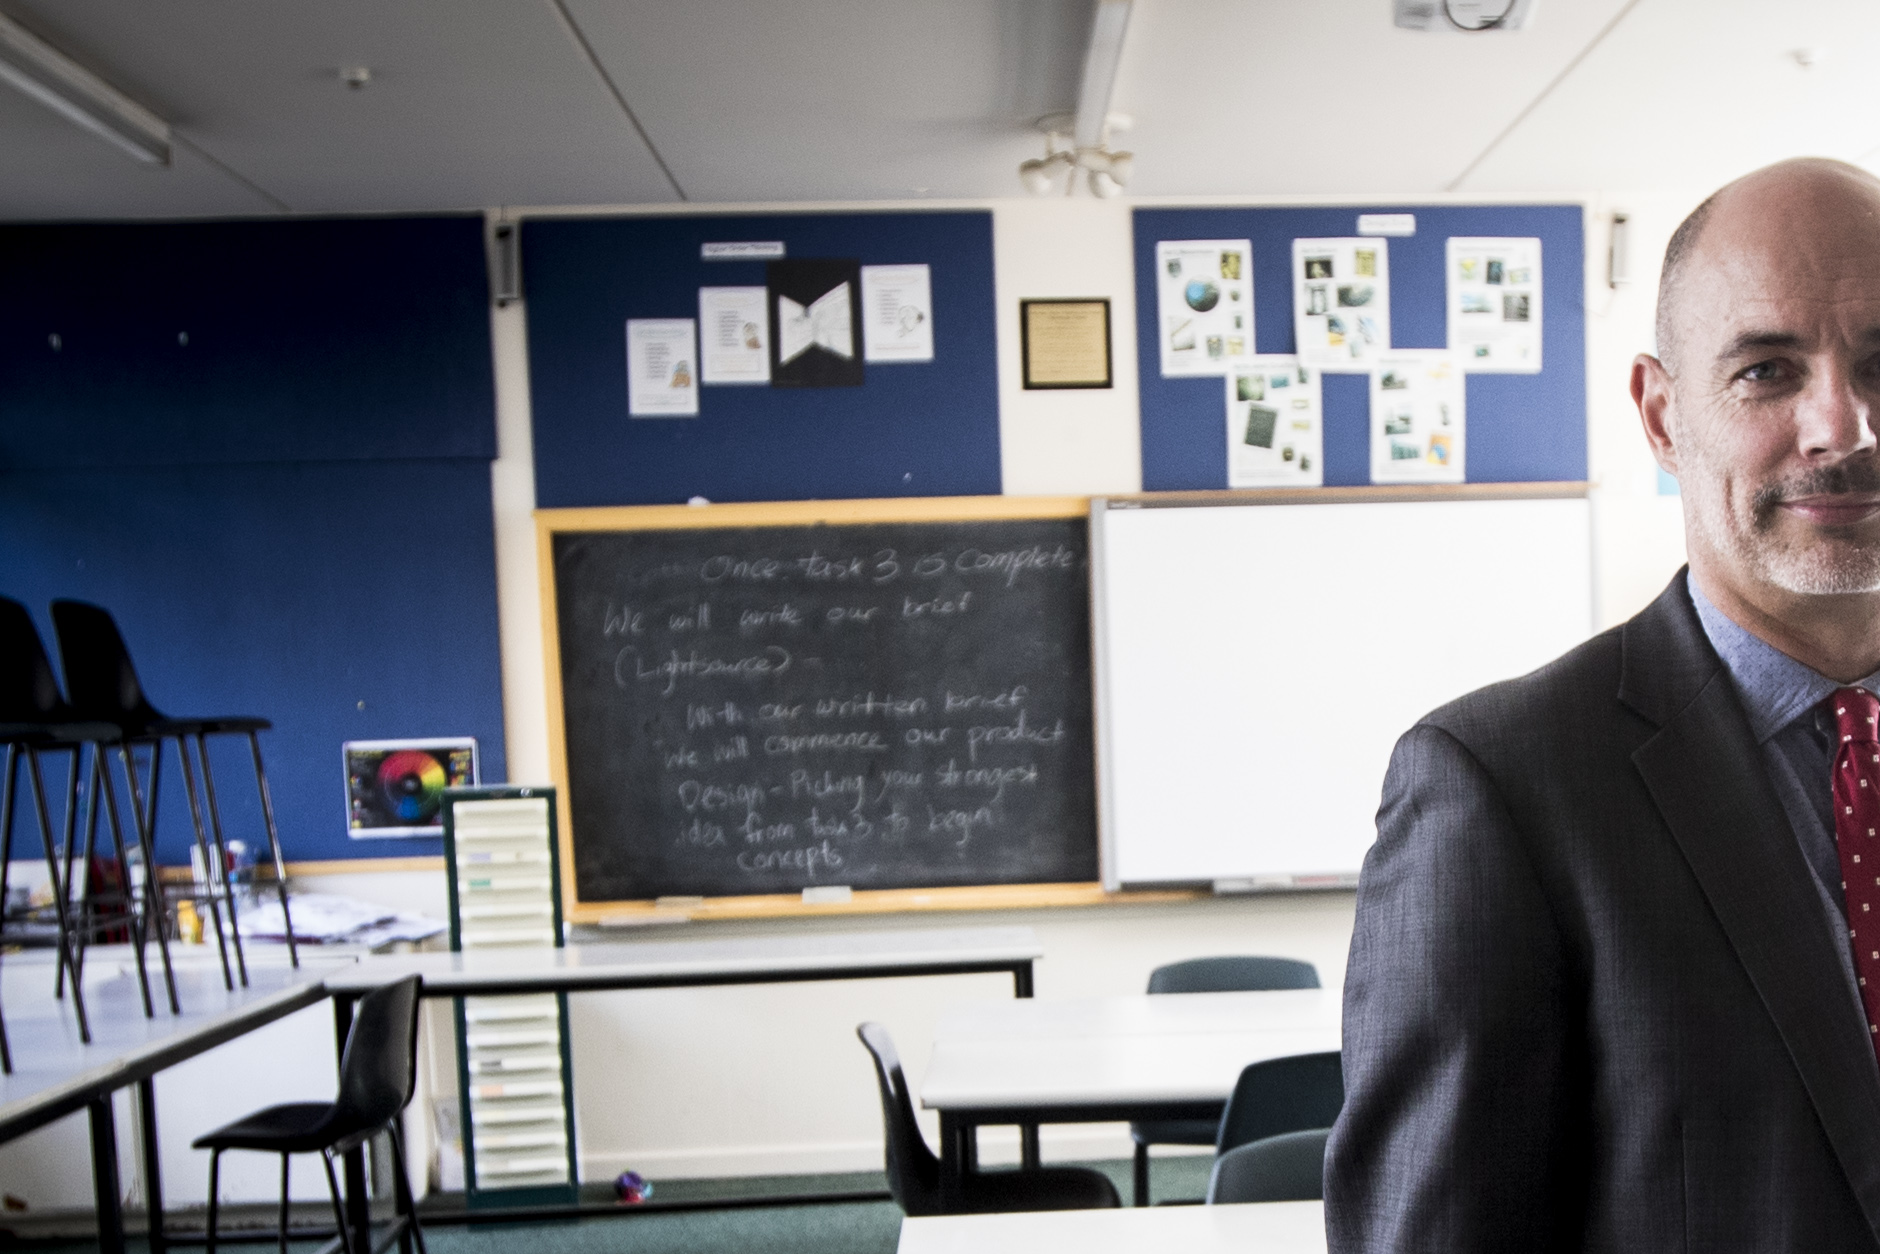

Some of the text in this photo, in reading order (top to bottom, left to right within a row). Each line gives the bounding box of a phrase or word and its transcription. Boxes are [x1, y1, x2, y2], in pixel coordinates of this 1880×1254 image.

[701, 555, 780, 583] Once
[872, 548, 899, 584] 3
[603, 602, 647, 638] We
[669, 602, 712, 633] will
[826, 606, 879, 624] our
[903, 591, 973, 618] brief
[758, 703, 802, 721] our
[815, 692, 927, 719] written
[946, 685, 1029, 714] brief
[714, 735, 750, 763] will
[764, 732, 889, 756] commence
[905, 727, 952, 745] our
[967, 709, 1067, 763] product
[736, 839, 843, 878] concepts
